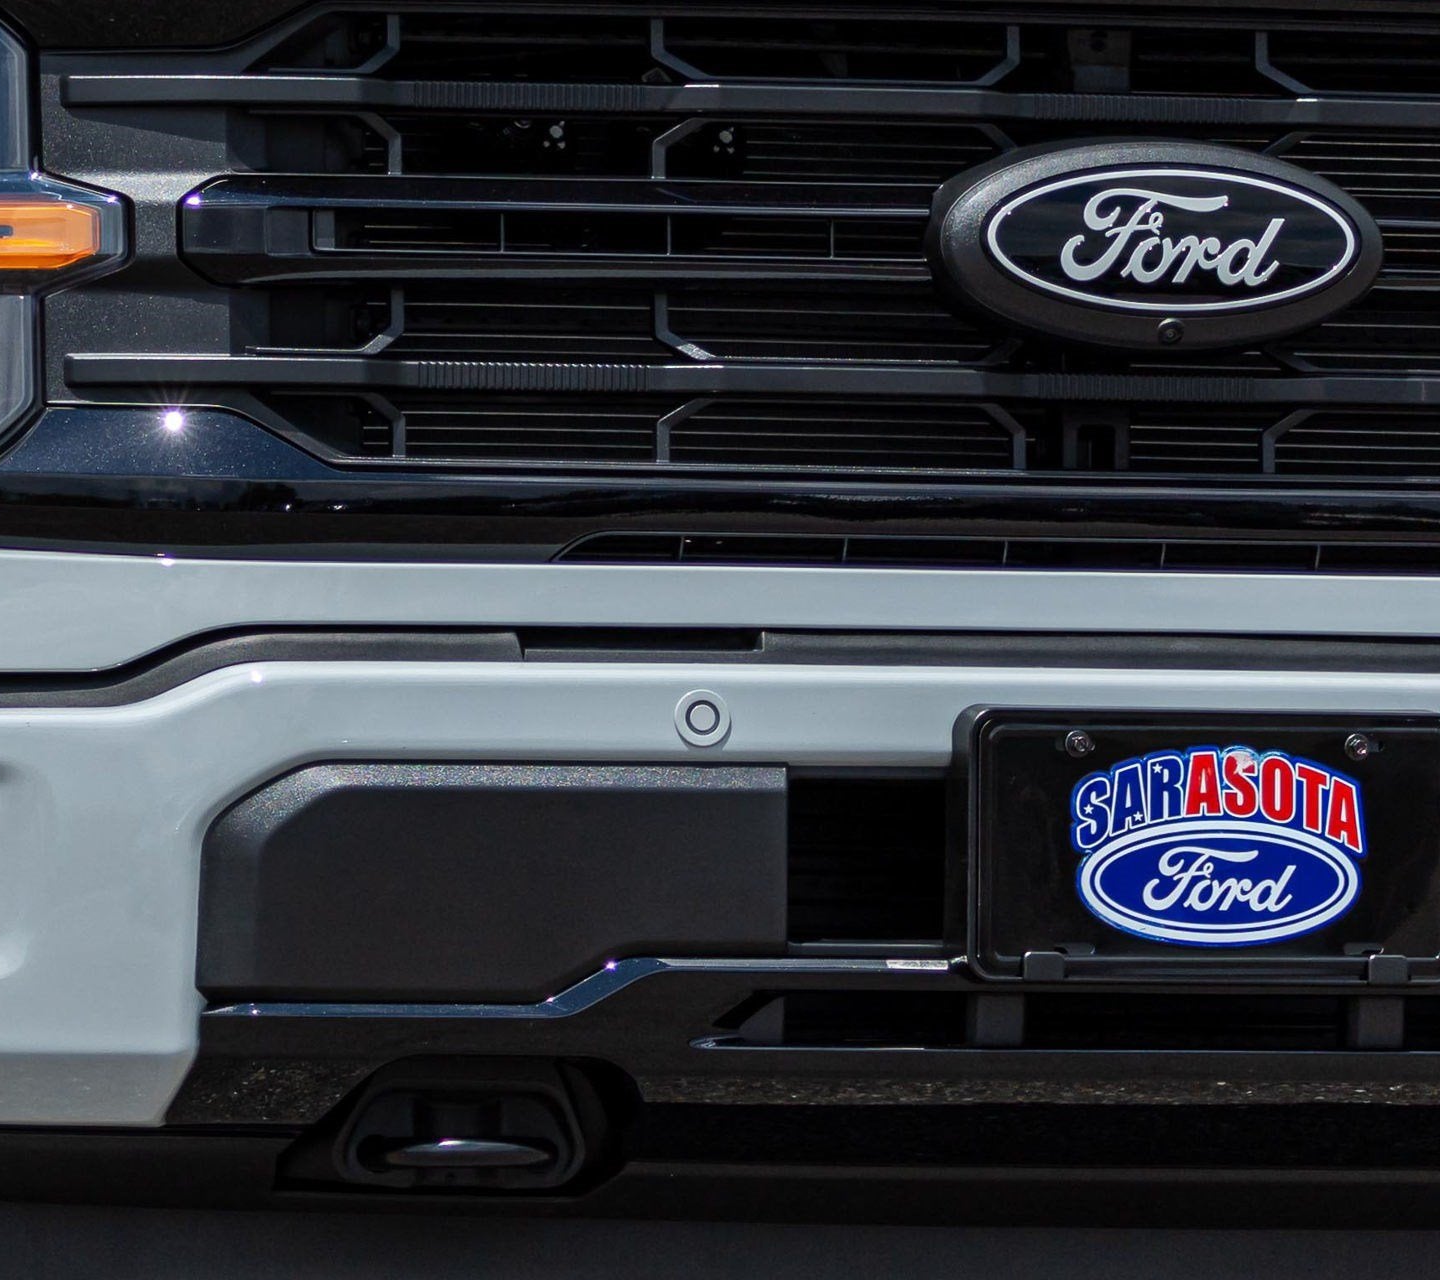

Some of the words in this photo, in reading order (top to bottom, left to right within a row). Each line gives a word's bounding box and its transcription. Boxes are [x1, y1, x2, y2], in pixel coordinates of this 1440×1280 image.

[1060, 186, 1287, 287] Ford
[1074, 749, 1365, 854] SARASOTA
[1142, 845, 1297, 913] Ford
